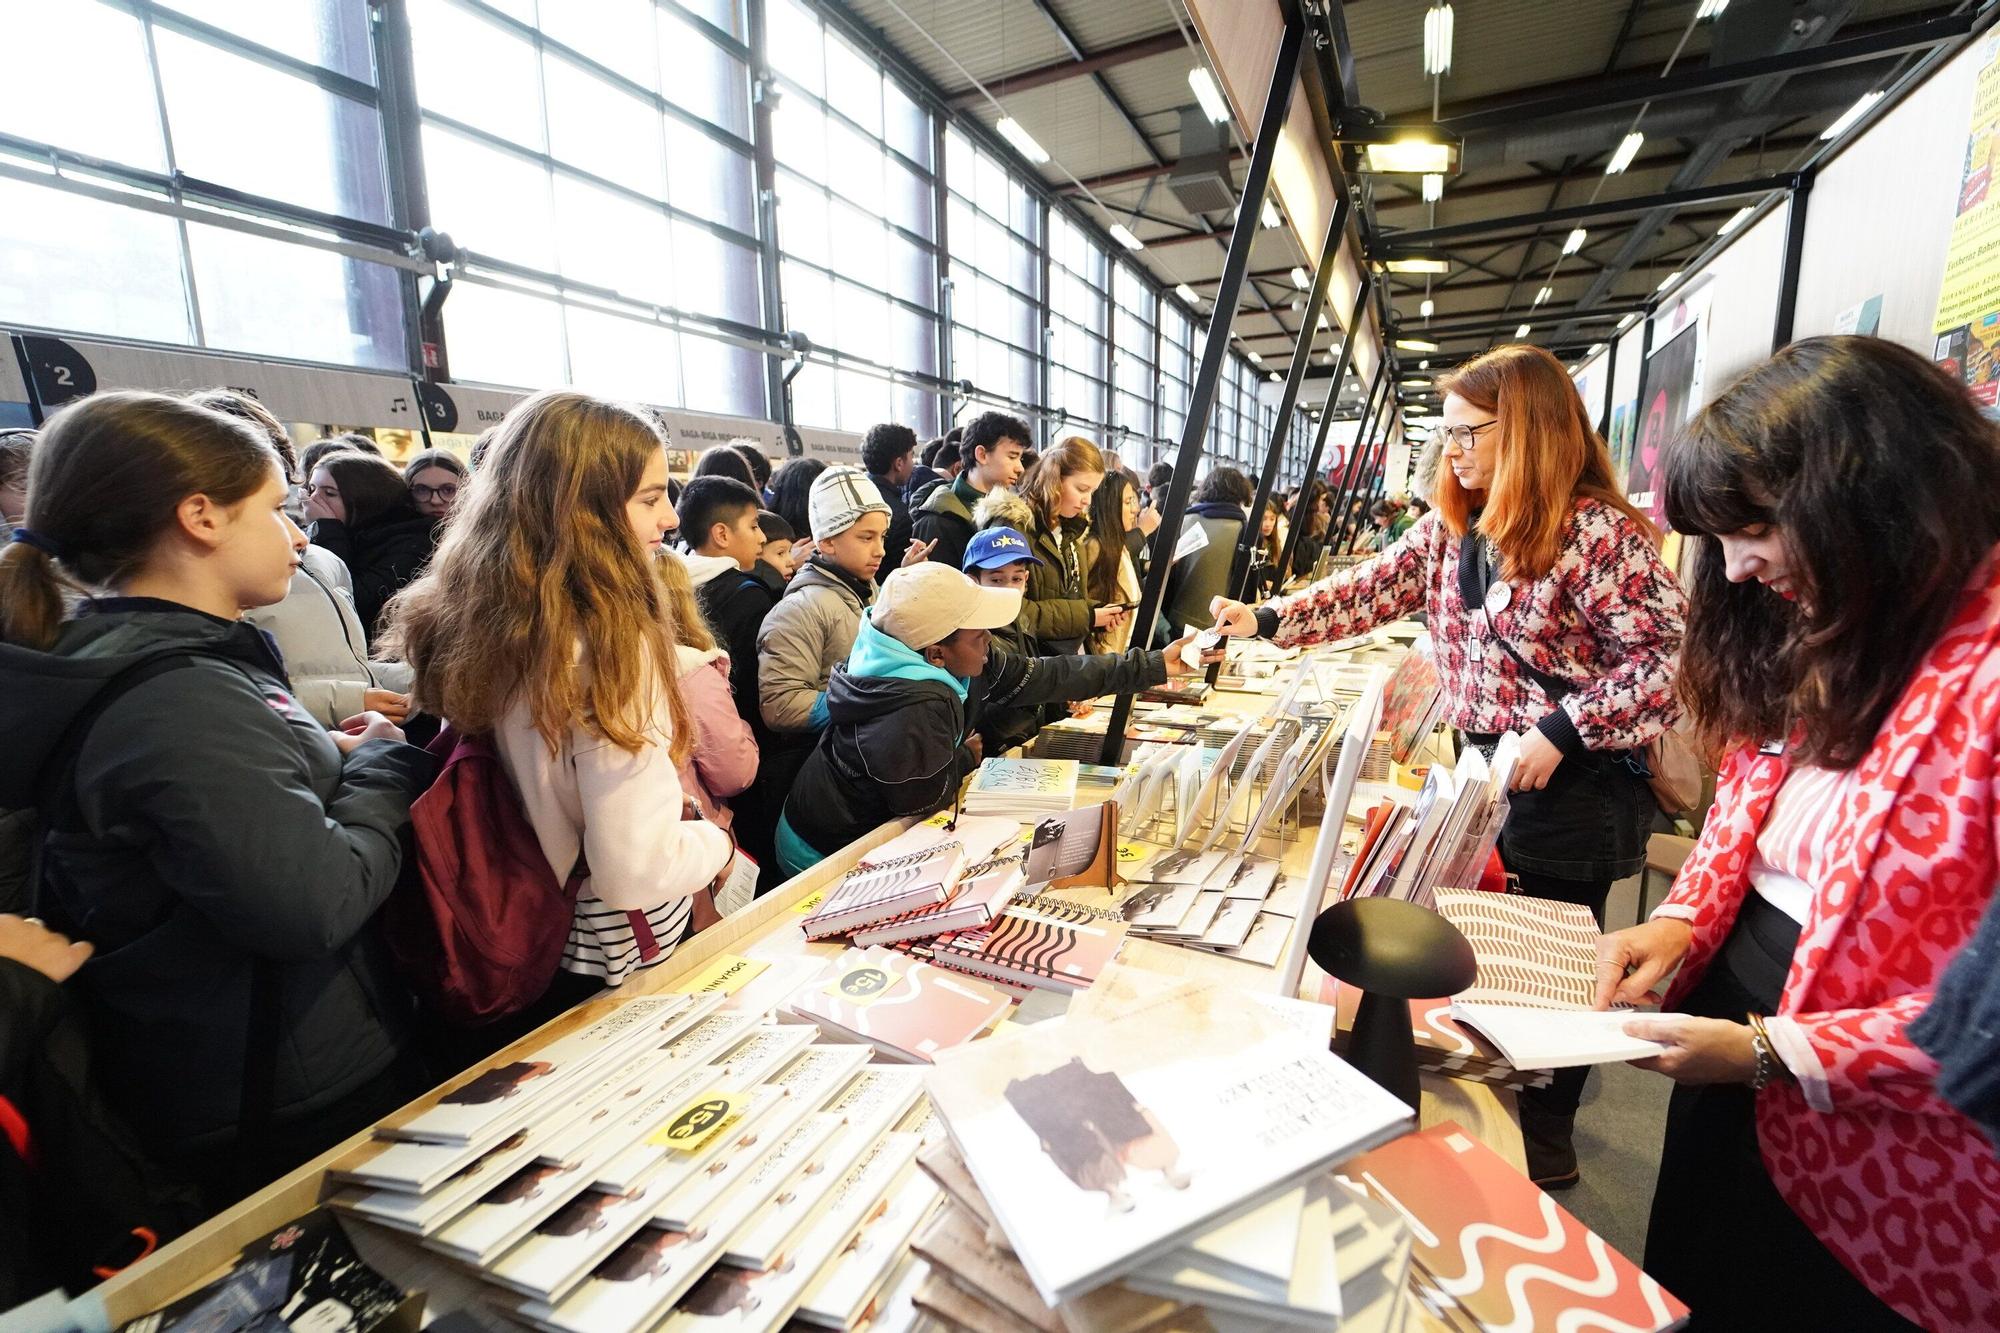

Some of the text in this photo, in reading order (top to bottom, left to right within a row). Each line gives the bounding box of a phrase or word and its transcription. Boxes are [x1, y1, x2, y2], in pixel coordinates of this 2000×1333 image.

[53, 366, 75, 387] 2
[436, 401, 447, 418] 3
[845, 972, 882, 994] 15€
[670, 1100, 728, 1139] 15€
